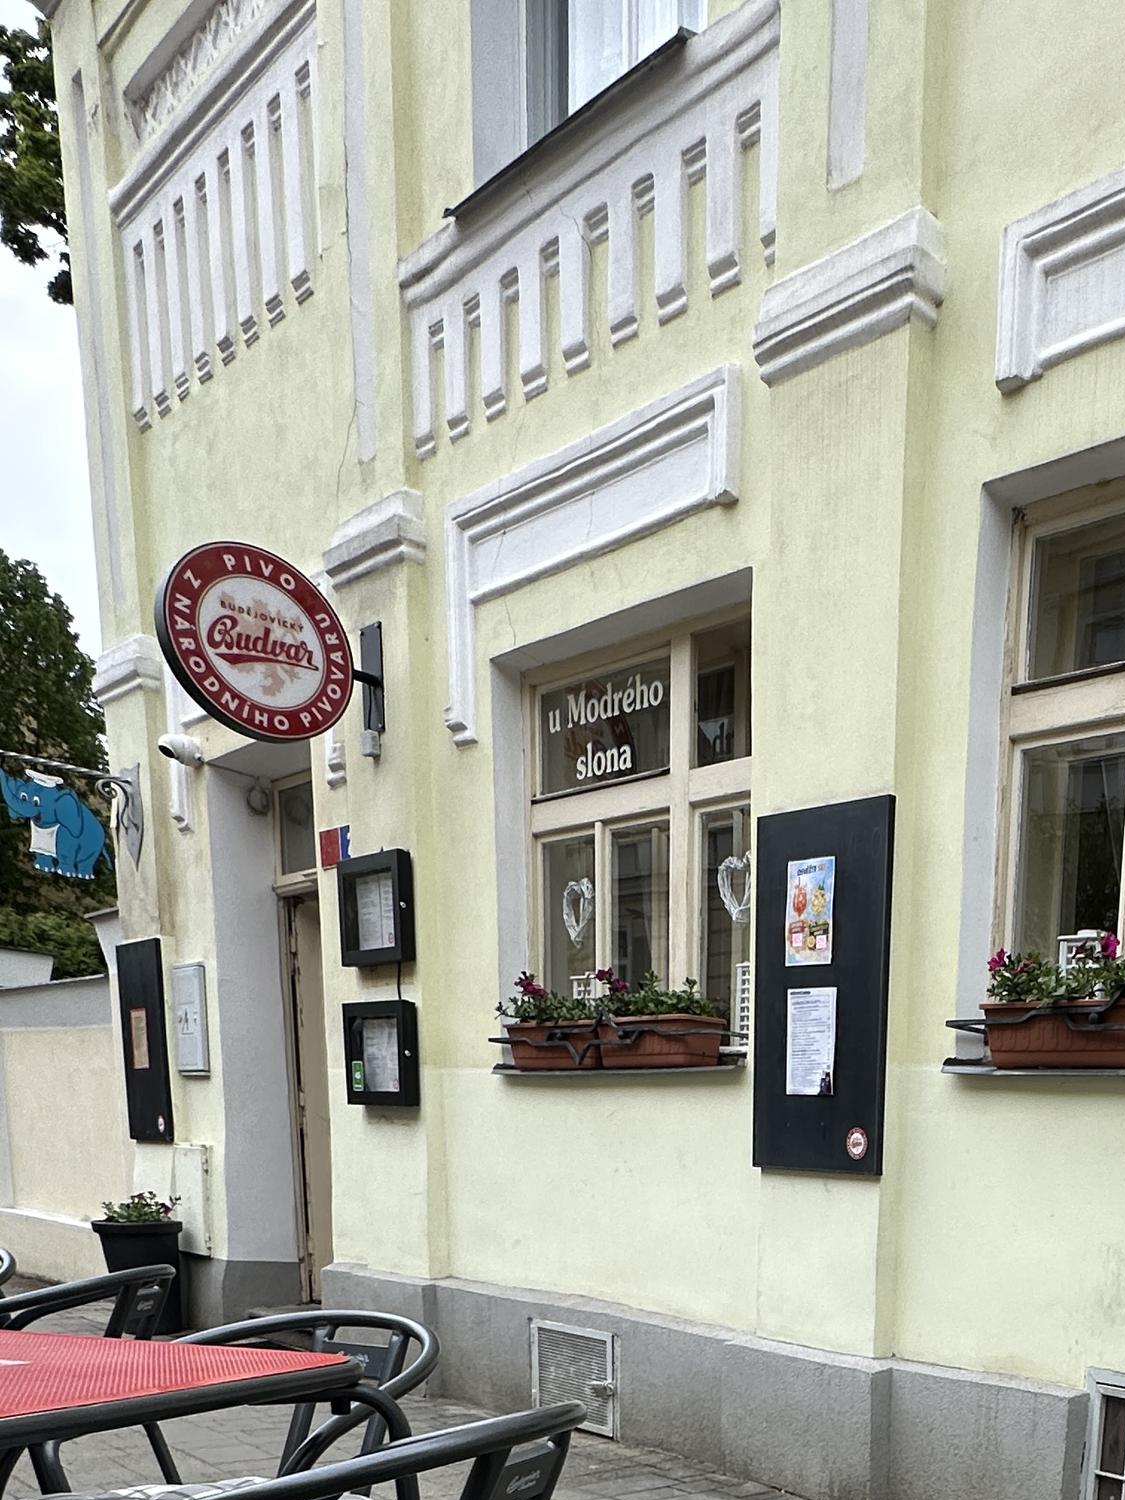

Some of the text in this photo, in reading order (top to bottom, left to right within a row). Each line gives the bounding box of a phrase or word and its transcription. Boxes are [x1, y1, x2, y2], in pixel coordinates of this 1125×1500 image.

[223, 554, 296, 590] PIVO
[207, 614, 316, 668] Budvar
[220, 600, 304, 633] BUDĚJOVICKÝ
[174, 593, 290, 731] NÁRODNÍHO
[299, 613, 345, 728] PIVOVARU
[548, 674, 664, 733] u Modrého
[576, 741, 632, 780] slona
